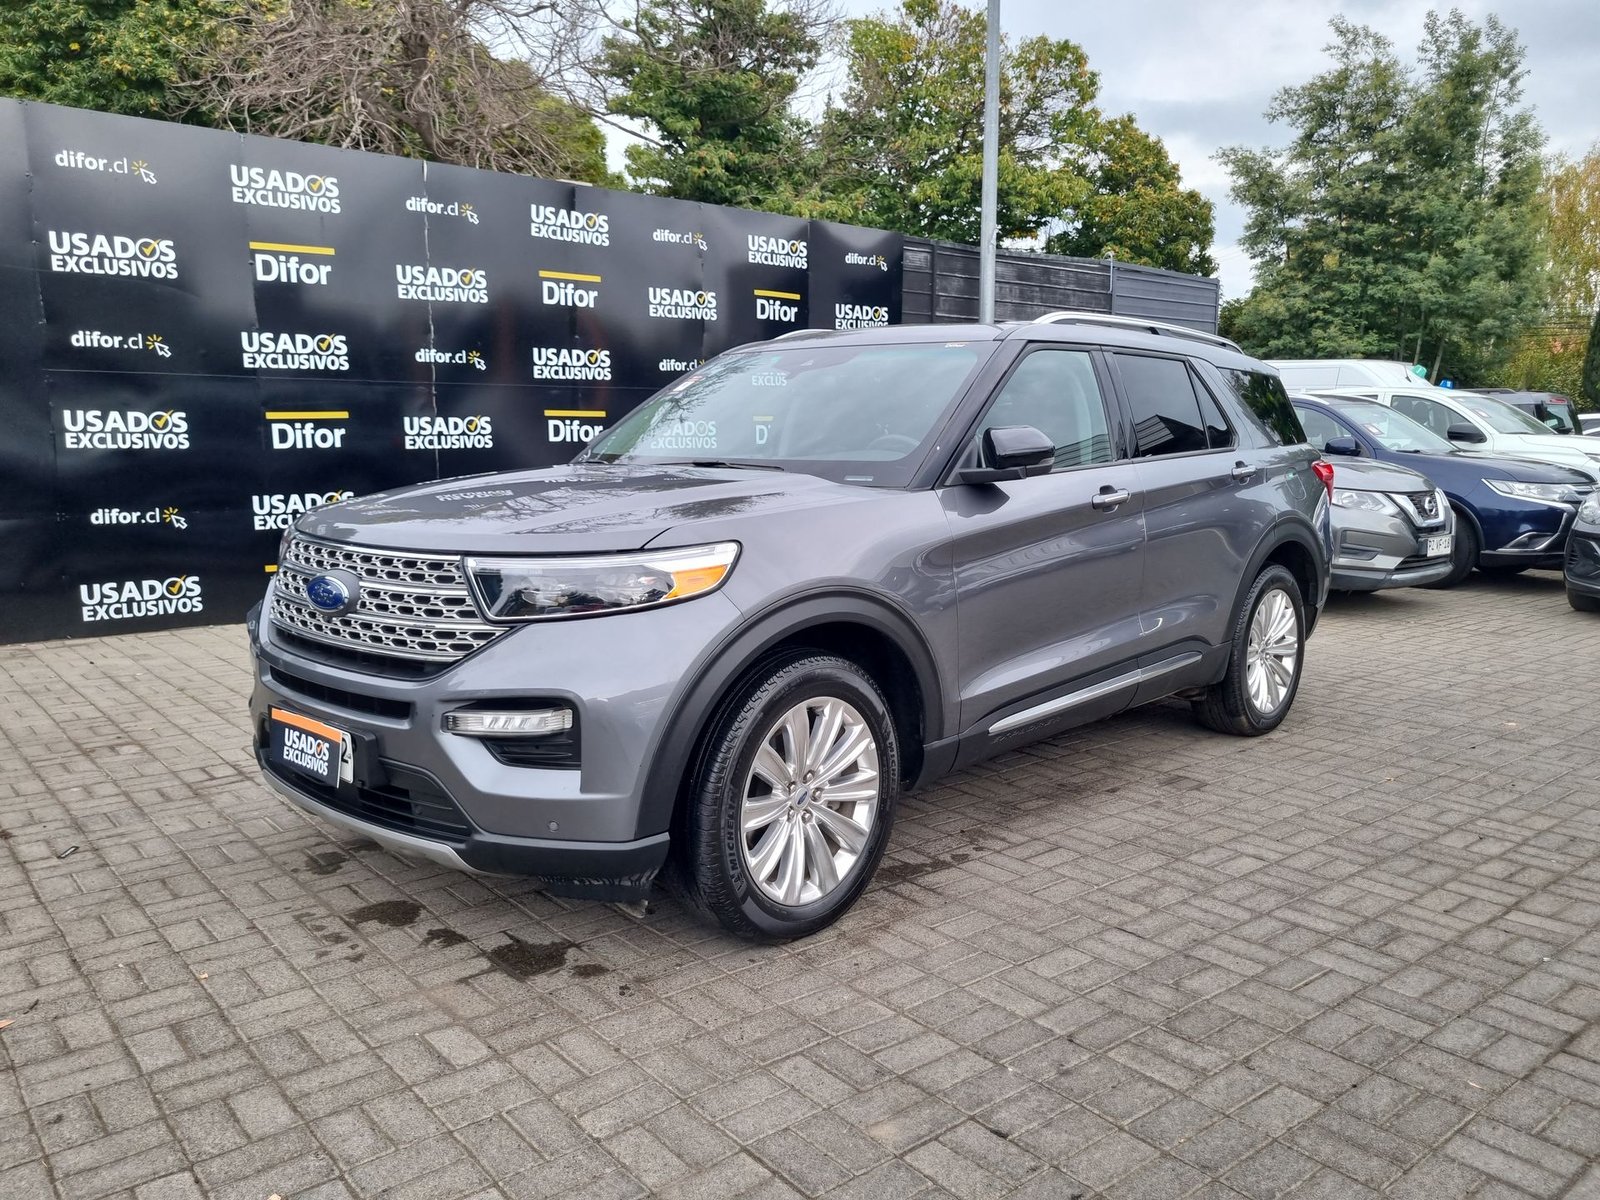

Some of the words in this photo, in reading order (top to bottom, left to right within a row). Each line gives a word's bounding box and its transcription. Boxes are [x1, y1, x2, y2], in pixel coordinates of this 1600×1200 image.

[55, 150, 128, 174] difor.cl
[230, 164, 340, 198] USADOS
[231, 186, 341, 214] EXCLUSIVOS
[405, 196, 459, 217] difor.cl
[530, 203, 609, 233] USADOS
[48, 231, 177, 262] USADOS
[530, 222, 610, 247] EXCLUSIVOS
[652, 229, 693, 245] difor.cl
[747, 234, 808, 258] USADOS
[50, 254, 178, 280] EXCLUSIVOS
[254, 253, 332, 286] Difor
[748, 251, 808, 270] EXCLUSIVOS
[844, 252, 876, 266] difor.cl
[396, 264, 488, 289] USADOS
[397, 284, 488, 304] EXCLUSIVOS
[542, 280, 599, 309] Difor
[648, 287, 717, 309] USADOS
[648, 303, 718, 321] EXCLUSIVOS
[756, 298, 798, 322] Difor
[835, 303, 889, 322] USADOS
[71, 330, 143, 349] difor.cl
[240, 331, 348, 356] USADOS
[242, 352, 350, 371] EXCLUSIVOS
[415, 348, 467, 364] difor.cl
[532, 347, 612, 367] USADOS
[533, 365, 612, 381] EXCLUSIVOS
[63, 409, 188, 434] USADOS
[403, 416, 492, 436] USADOS
[64, 432, 190, 449] EXCLUSIVOS
[271, 422, 346, 450] Difor
[404, 434, 494, 450] EXCLUSIVOS
[90, 508, 160, 525] difor.cl
[80, 576, 201, 605] USADOS
[82, 597, 203, 622] EXCLUSIVOS
[284, 728, 330, 760] USADOS
[283, 746, 329, 776] EXCLUSIVOS
